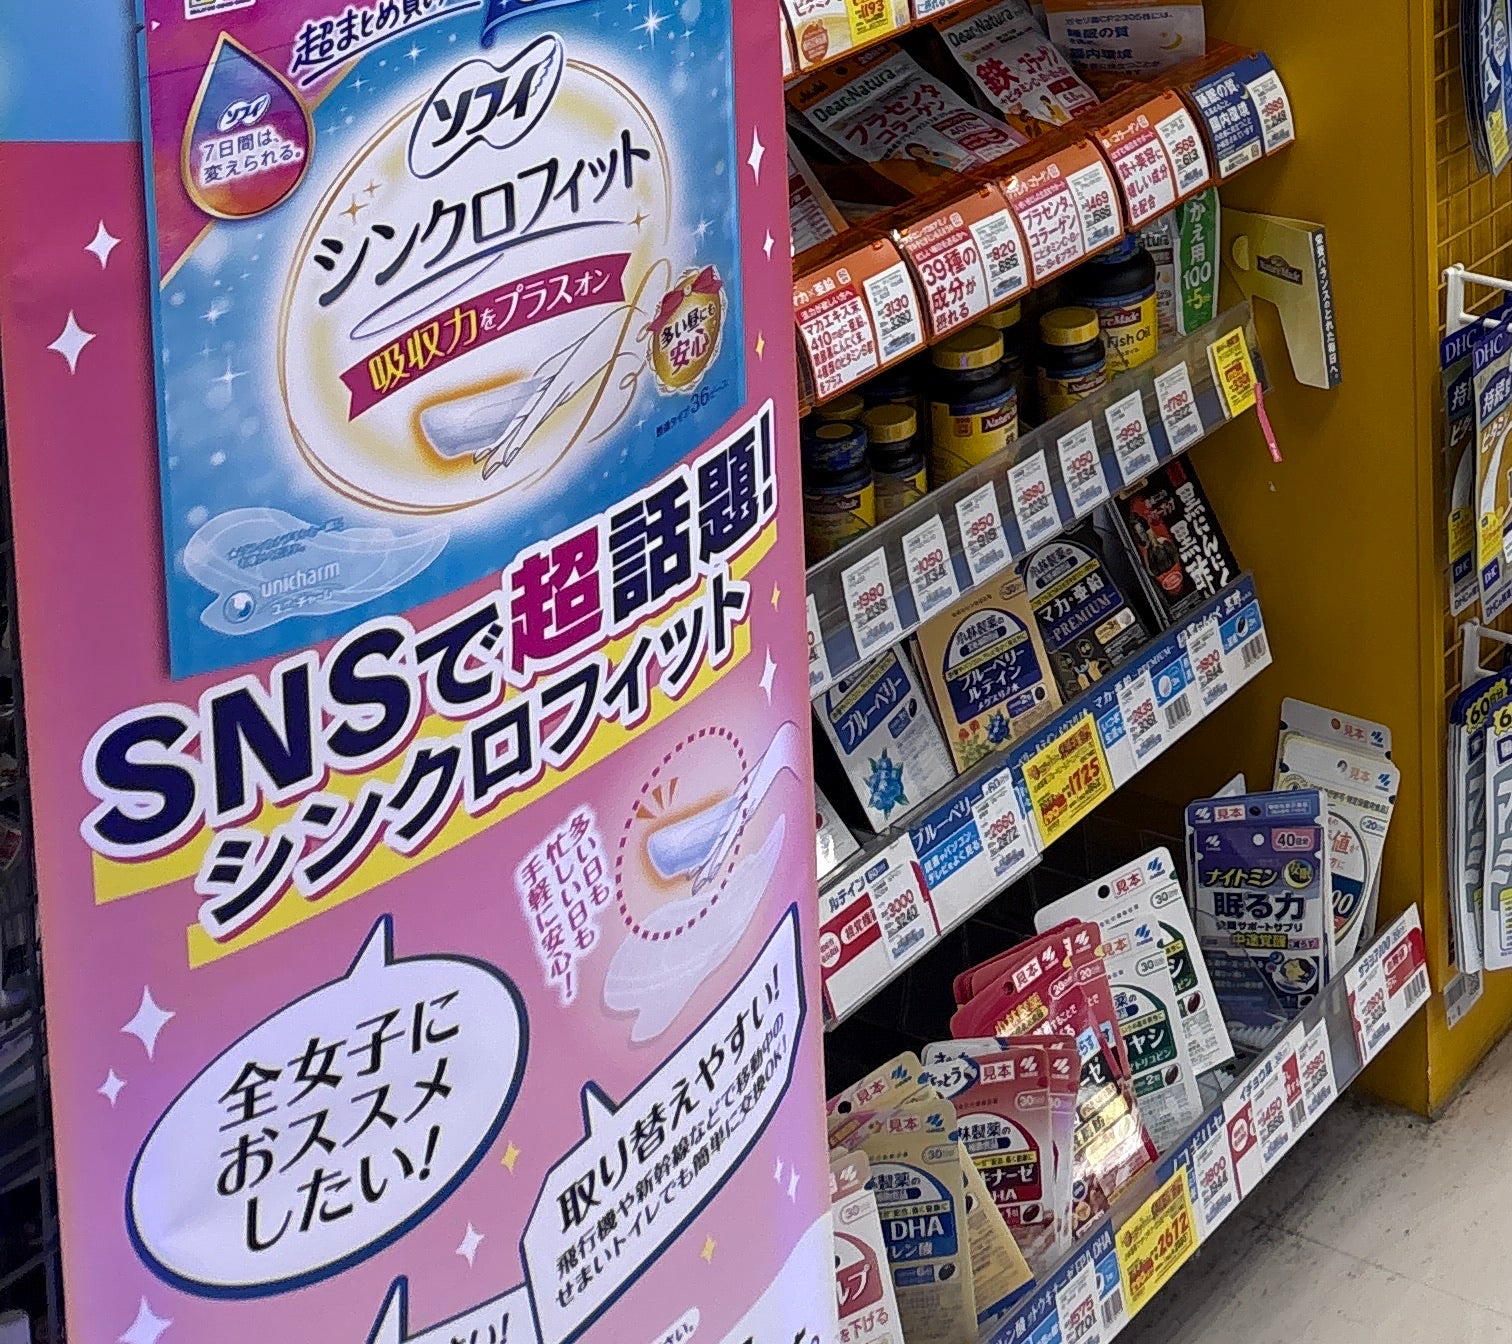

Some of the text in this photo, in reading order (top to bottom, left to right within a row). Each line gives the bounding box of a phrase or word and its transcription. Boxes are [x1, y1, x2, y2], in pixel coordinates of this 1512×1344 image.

[975, 58, 1020, 96] 鉄
[431, 74, 534, 149] ソフィ
[314, 130, 651, 306] シンクロフィット
[921, 245, 978, 288] 39種の
[931, 276, 976, 311] 成分が
[368, 268, 611, 393] 吸収力をプラスオン
[669, 329, 710, 372] 安心
[1475, 334, 1503, 370] DHC
[260, 560, 340, 599] unicharm
[958, 649, 1025, 692] ブルーベリー
[969, 667, 1022, 702] ルテイン
[841, 676, 903, 746] ブルーベリー
[206, 574, 748, 926] シンクロフィット
[1216, 807, 1244, 820] 見本
[568, 812, 611, 905] 多い日も
[1205, 869, 1278, 886] ナイトミン
[546, 837, 596, 950] 忙しい日も
[828, 875, 865, 913] ルテイン
[1115, 871, 1142, 896] 見本
[1213, 892, 1305, 920] 眠る力
[1015, 964, 1039, 987] 見本
[218, 987, 459, 1125] 全女子に
[983, 1064, 1012, 1082] 見本
[857, 1081, 885, 1103] 見本
[216, 1072, 454, 1199] おススメ
[889, 1118, 918, 1132] 見本
[891, 1217, 944, 1240] DHA
